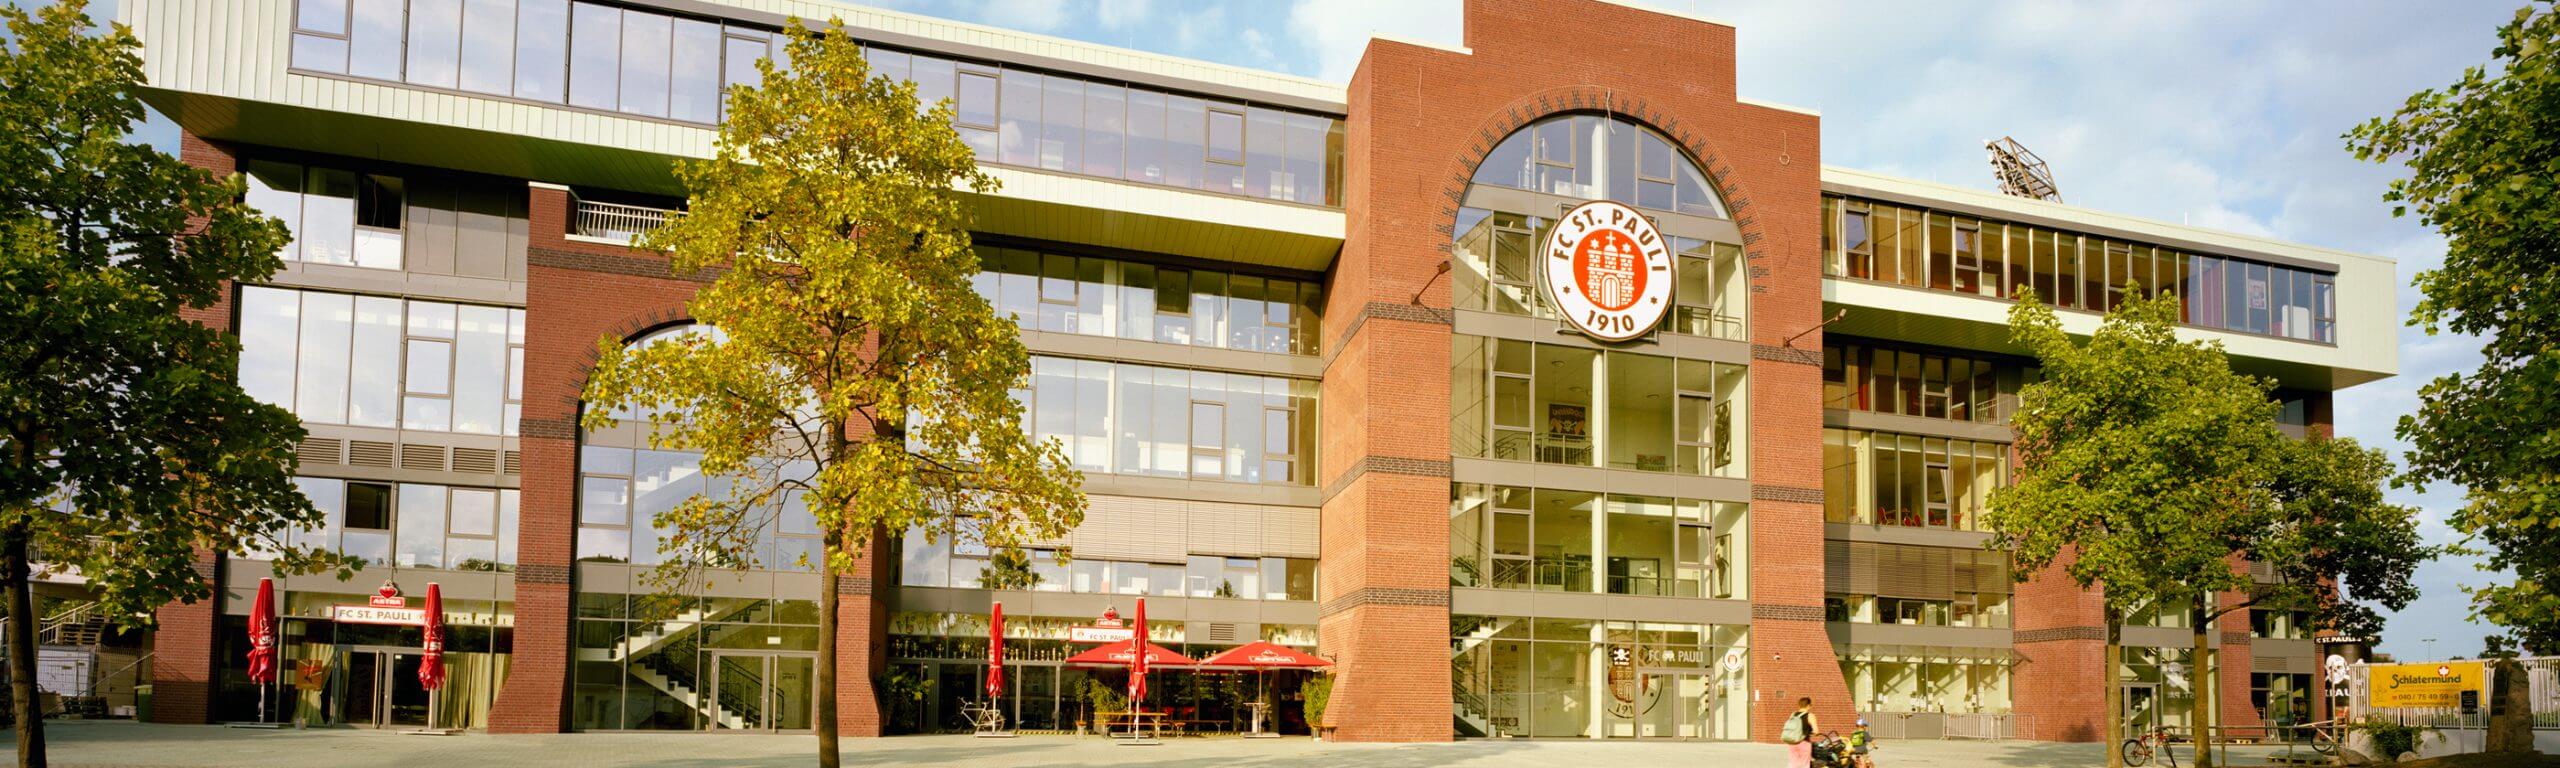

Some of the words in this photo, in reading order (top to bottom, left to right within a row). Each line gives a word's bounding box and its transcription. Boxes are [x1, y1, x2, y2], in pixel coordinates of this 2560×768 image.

[1553, 233, 1573, 260] FC
[1572, 208, 1602, 232] ST.
[1611, 208, 1666, 271] PAULI
[1586, 309, 1634, 333] 1910
[339, 609, 353, 617] FC
[356, 610, 371, 619] ST.
[377, 611, 411, 620] PAULI
[1678, 651, 1704, 663] PAULI
[2390, 673, 2461, 689] Schlatermund
